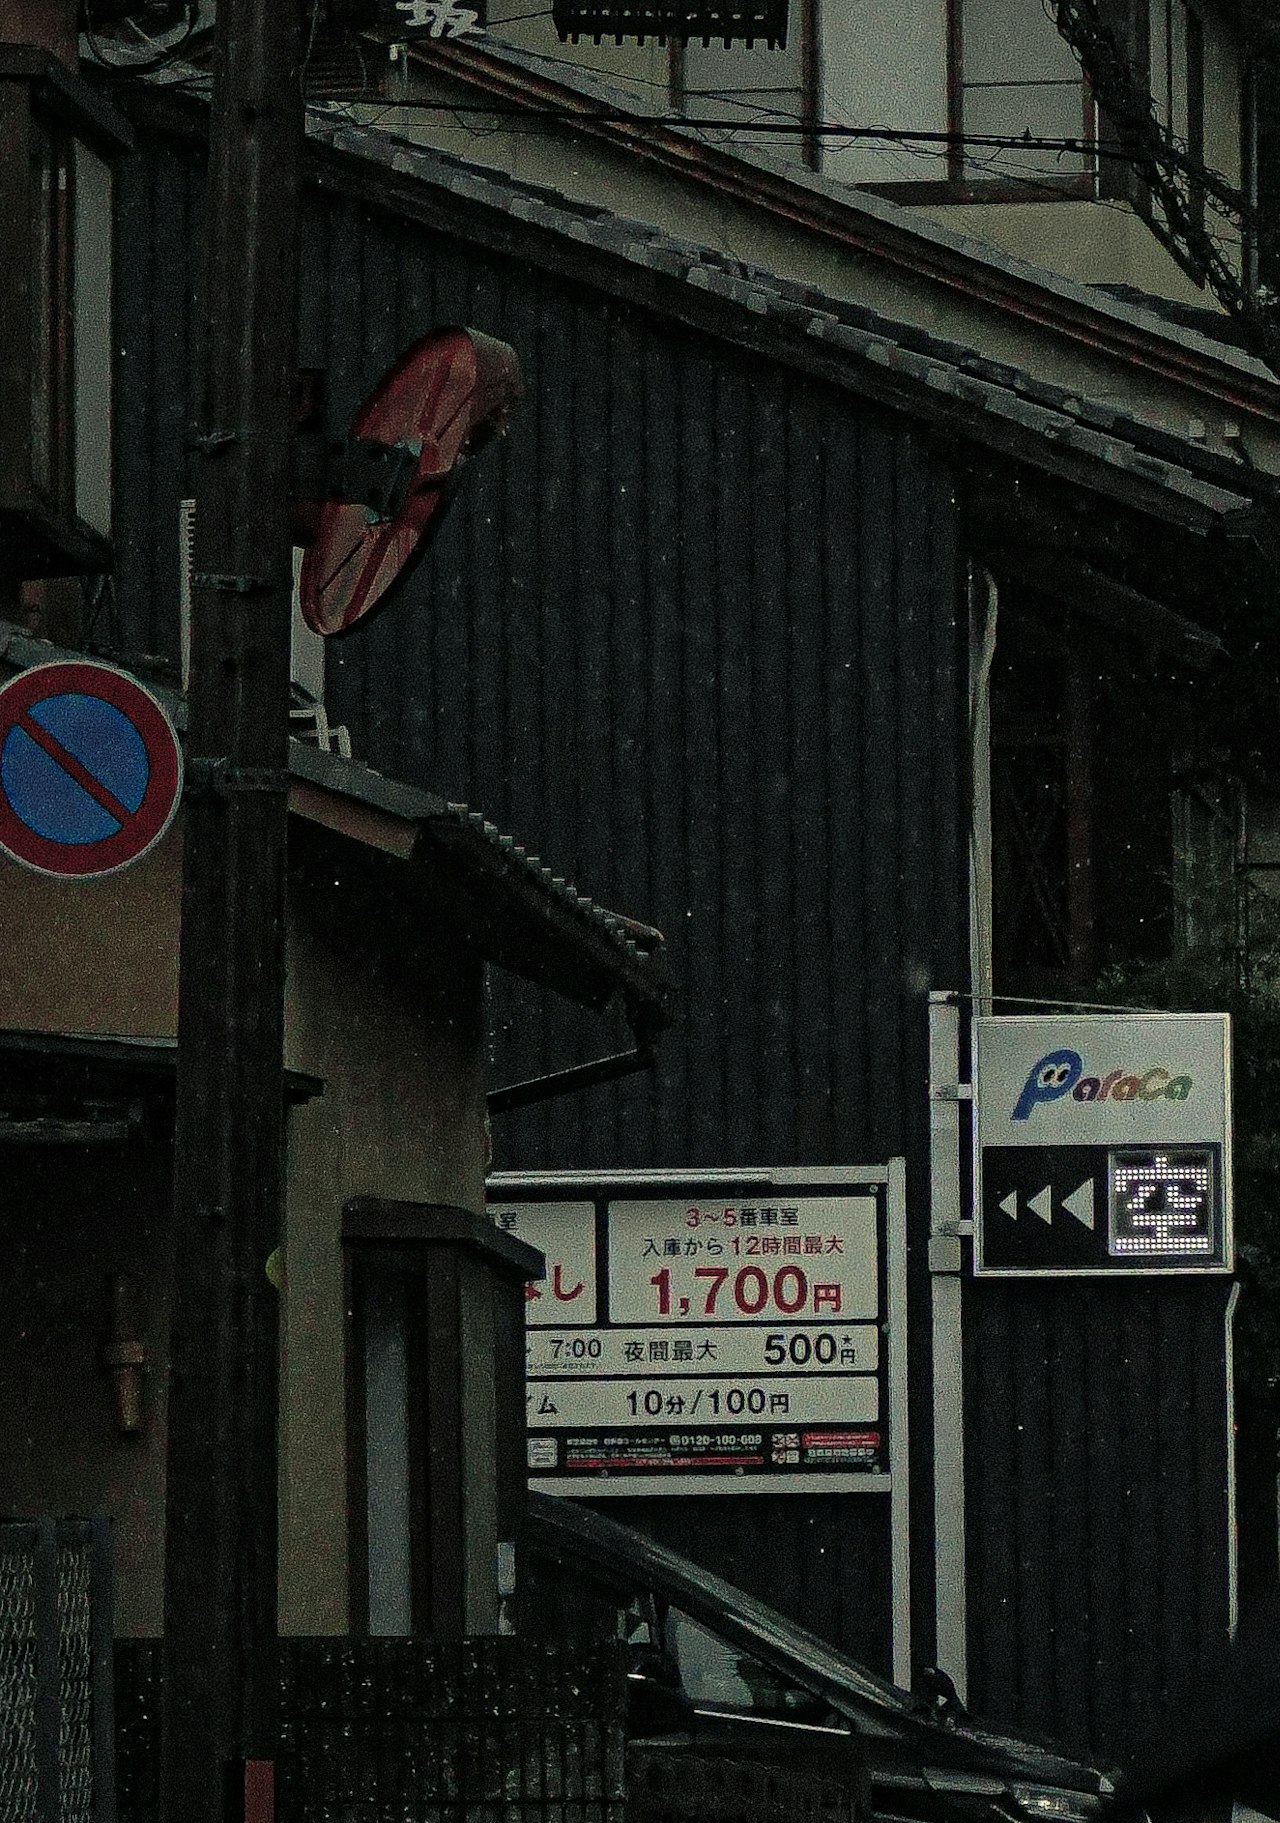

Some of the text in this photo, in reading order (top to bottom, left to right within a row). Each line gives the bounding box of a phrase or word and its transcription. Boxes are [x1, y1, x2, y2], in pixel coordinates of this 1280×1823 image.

[1114, 1155, 1208, 1250] 空
[650, 1263, 843, 1317] 1,700円
[551, 1338, 602, 1359] 7:00
[624, 1339, 718, 1362] 夜間最大
[626, 1388, 790, 1416] 10分/100円
